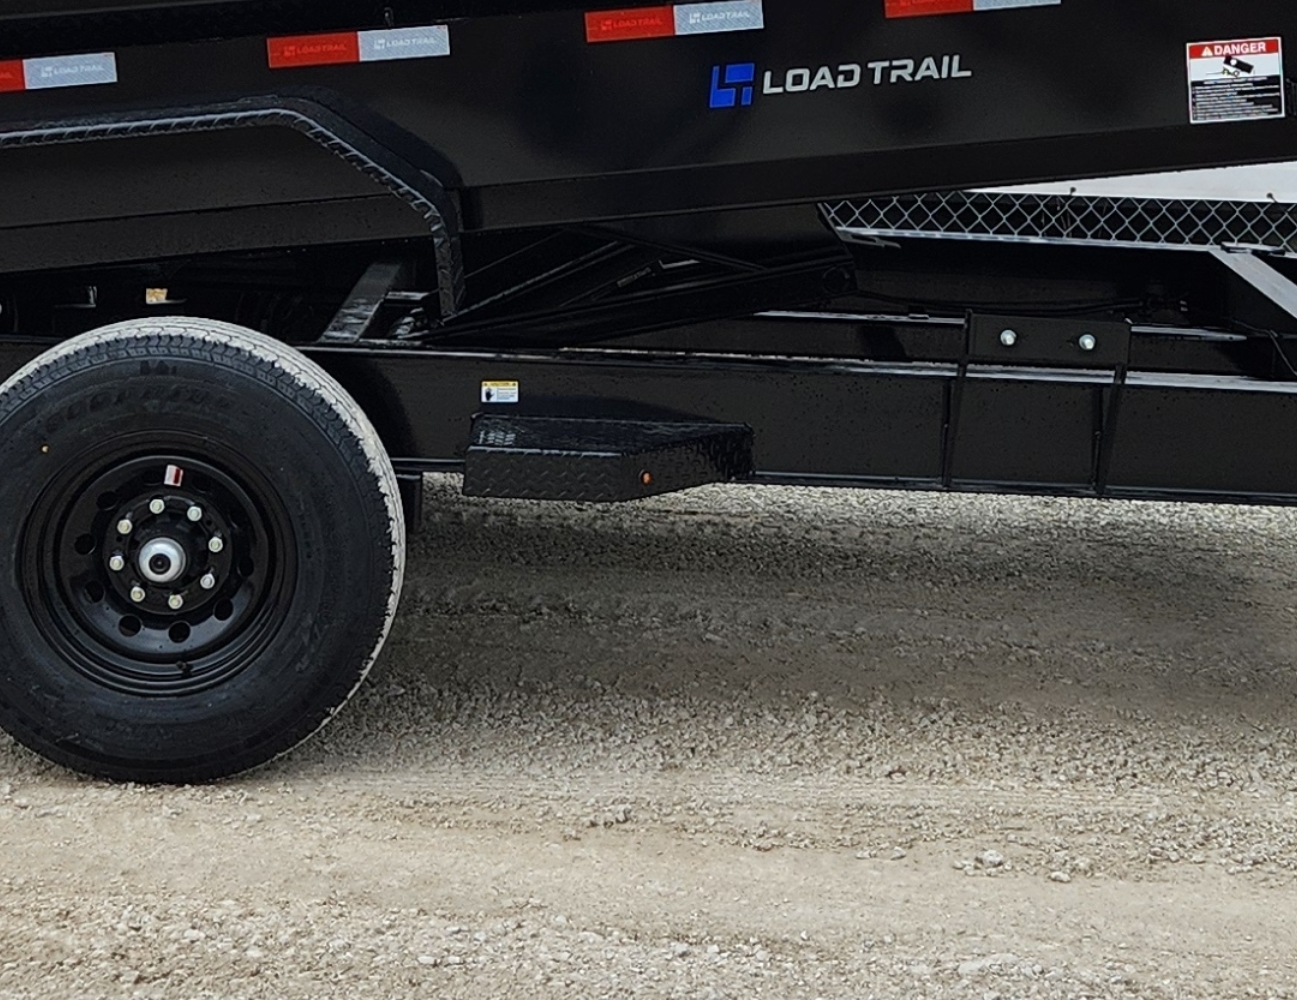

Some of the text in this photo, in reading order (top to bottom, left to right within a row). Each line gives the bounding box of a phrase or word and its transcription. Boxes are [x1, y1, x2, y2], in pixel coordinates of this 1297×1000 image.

[702, 10, 751, 21] LOAD TRAIL
[386, 37, 435, 48] LOAD TRAIL
[1214, 42, 1267, 56] DANGER
[54, 63, 105, 75] LOAD TRAIL
[762, 54, 972, 95] LOAD TRAIL
